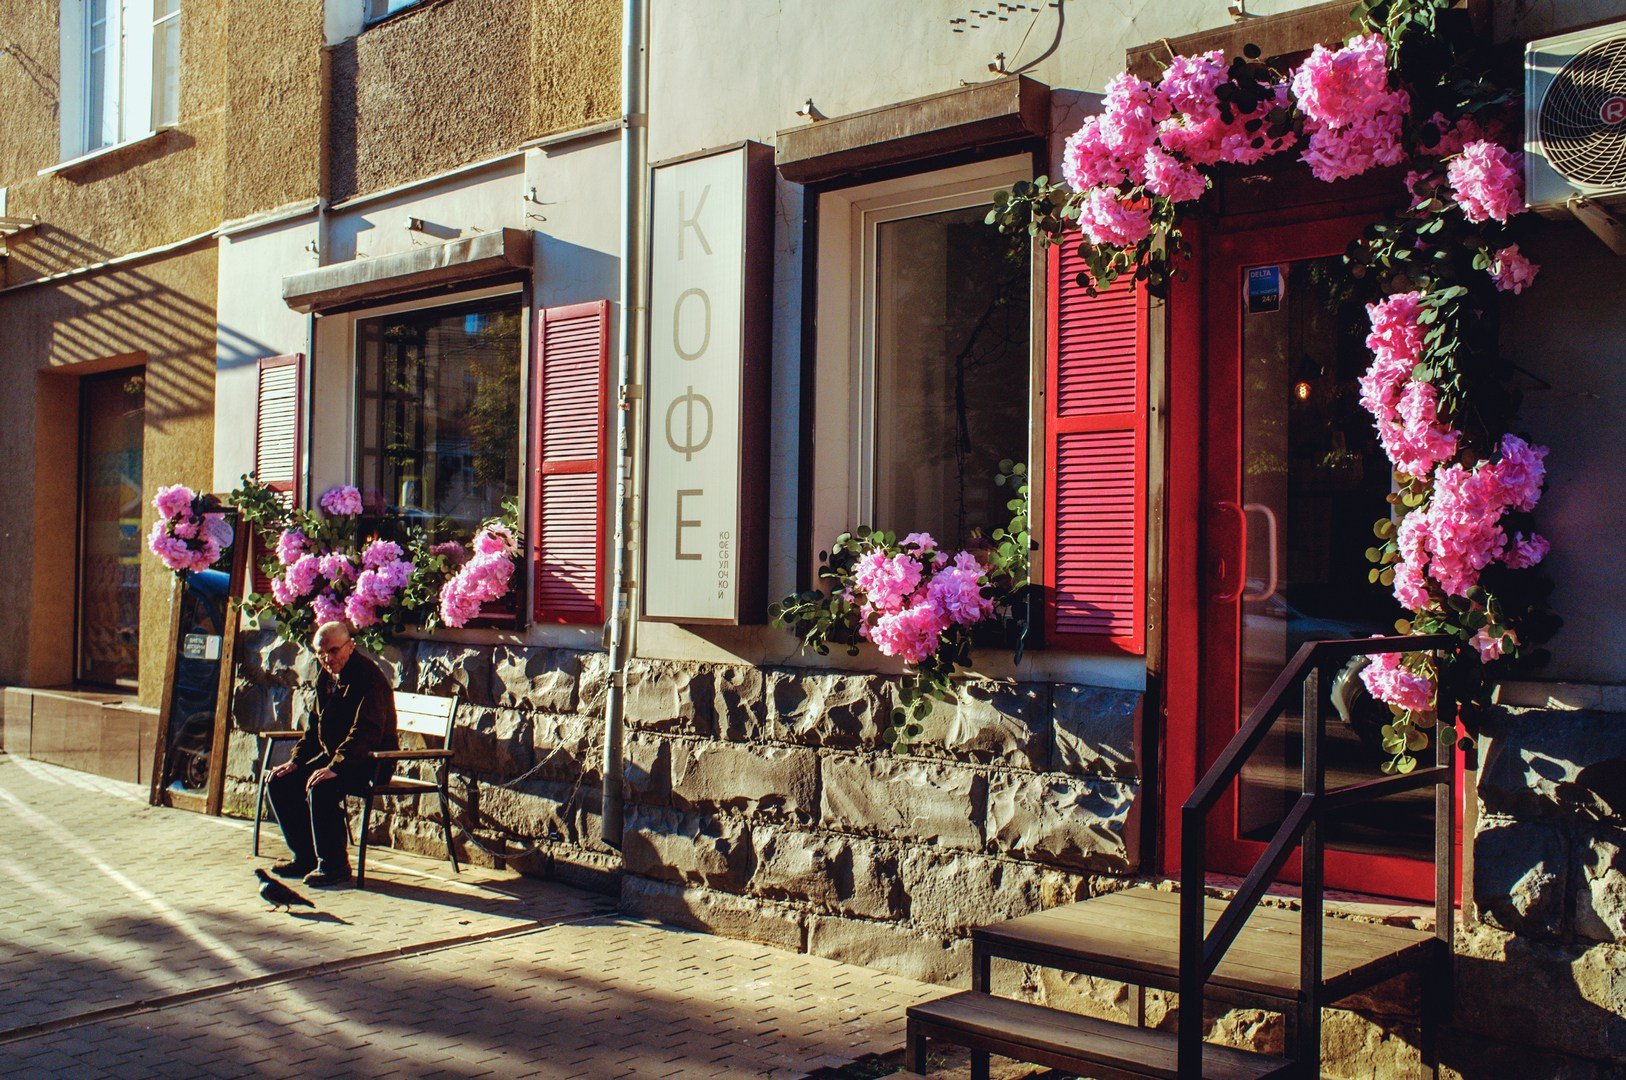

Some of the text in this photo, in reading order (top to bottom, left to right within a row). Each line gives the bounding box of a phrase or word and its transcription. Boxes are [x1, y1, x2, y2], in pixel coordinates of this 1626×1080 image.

[1250, 270, 1271, 278] DELTA
[1261, 295, 1277, 303] 24/7
[665, 184, 713, 561] КОФЕ
